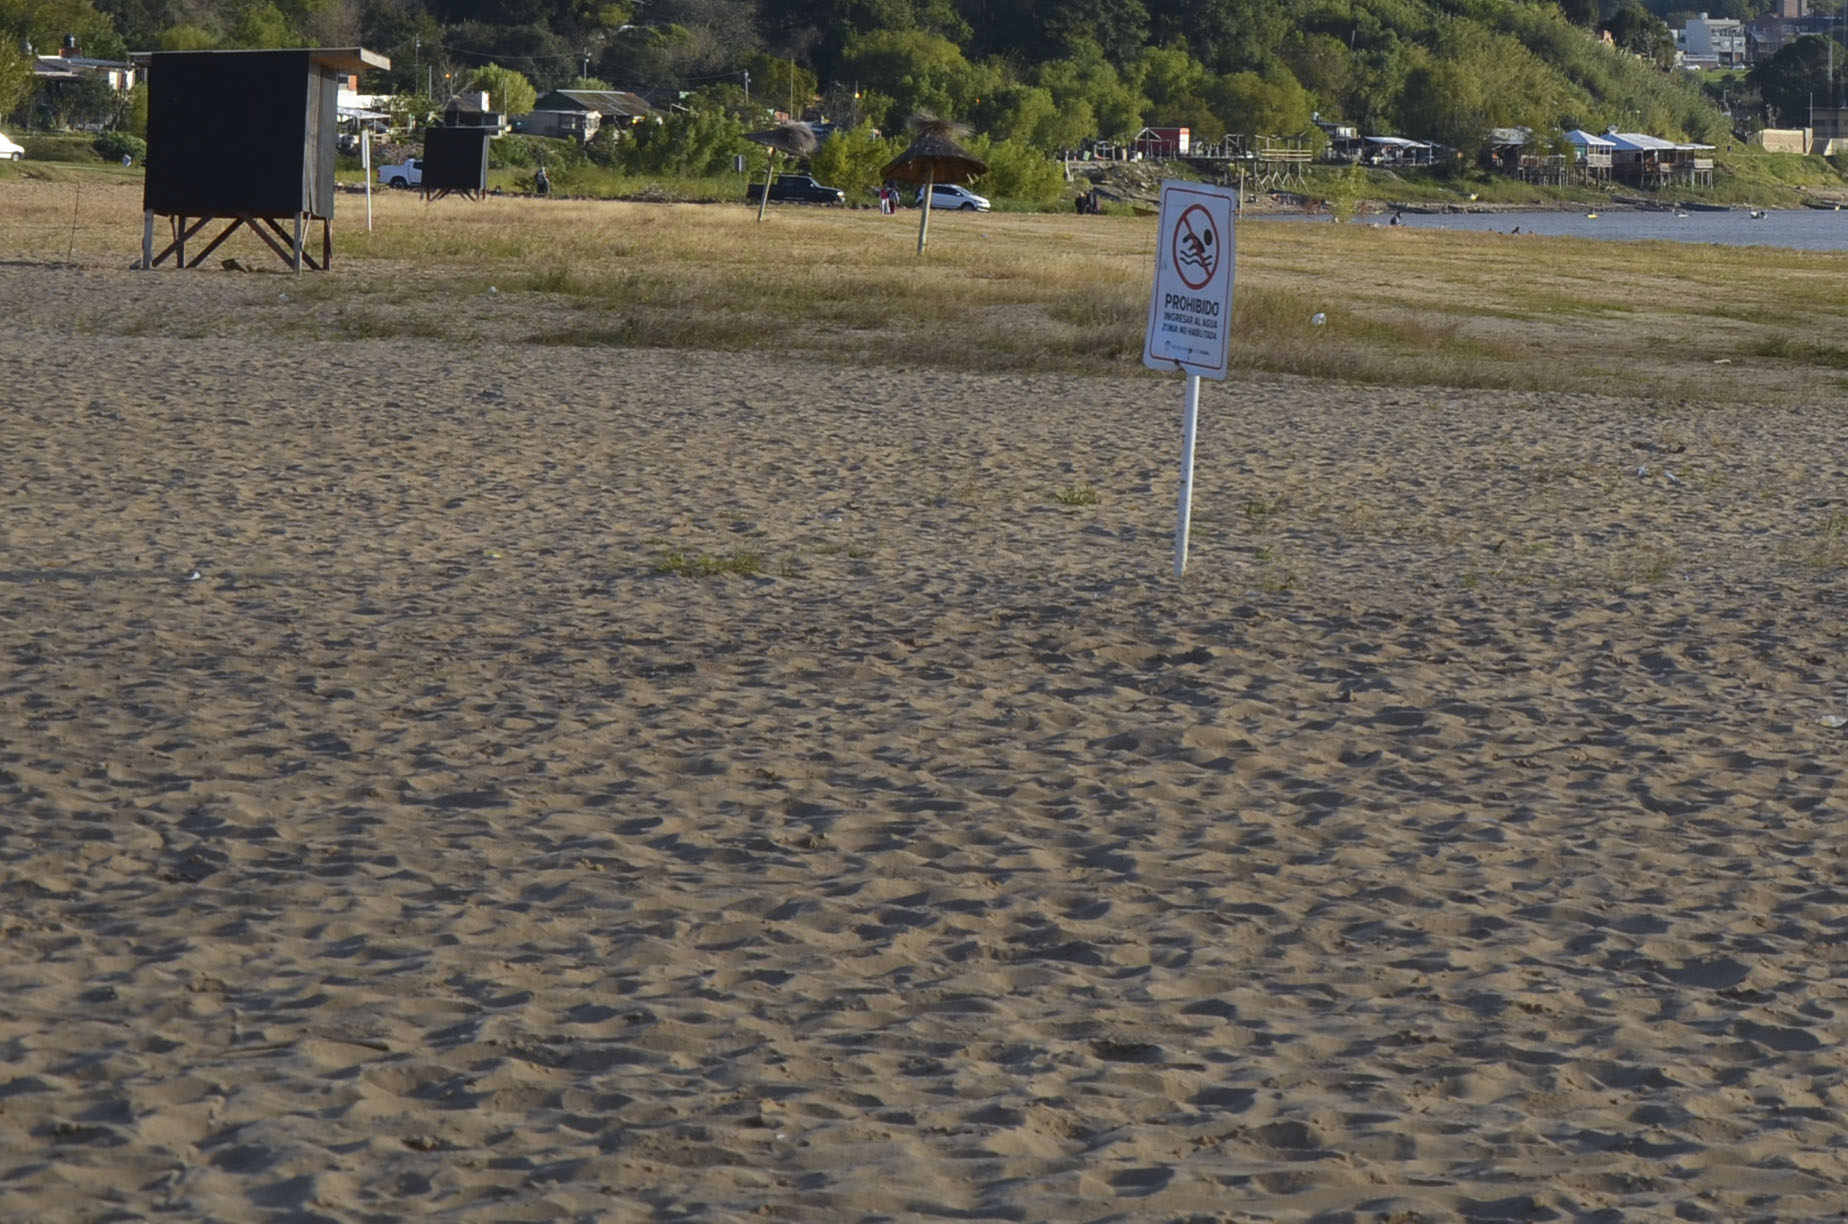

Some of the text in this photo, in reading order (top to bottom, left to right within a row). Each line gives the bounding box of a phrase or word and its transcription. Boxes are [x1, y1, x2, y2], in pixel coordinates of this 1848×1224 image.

[1165, 293, 1219, 316] PROHIBIDO
[1164, 311, 1217, 328] INGRESAR AL AGUA
[1162, 323, 1178, 333] ZONA
[1179, 325, 1187, 334] NO
